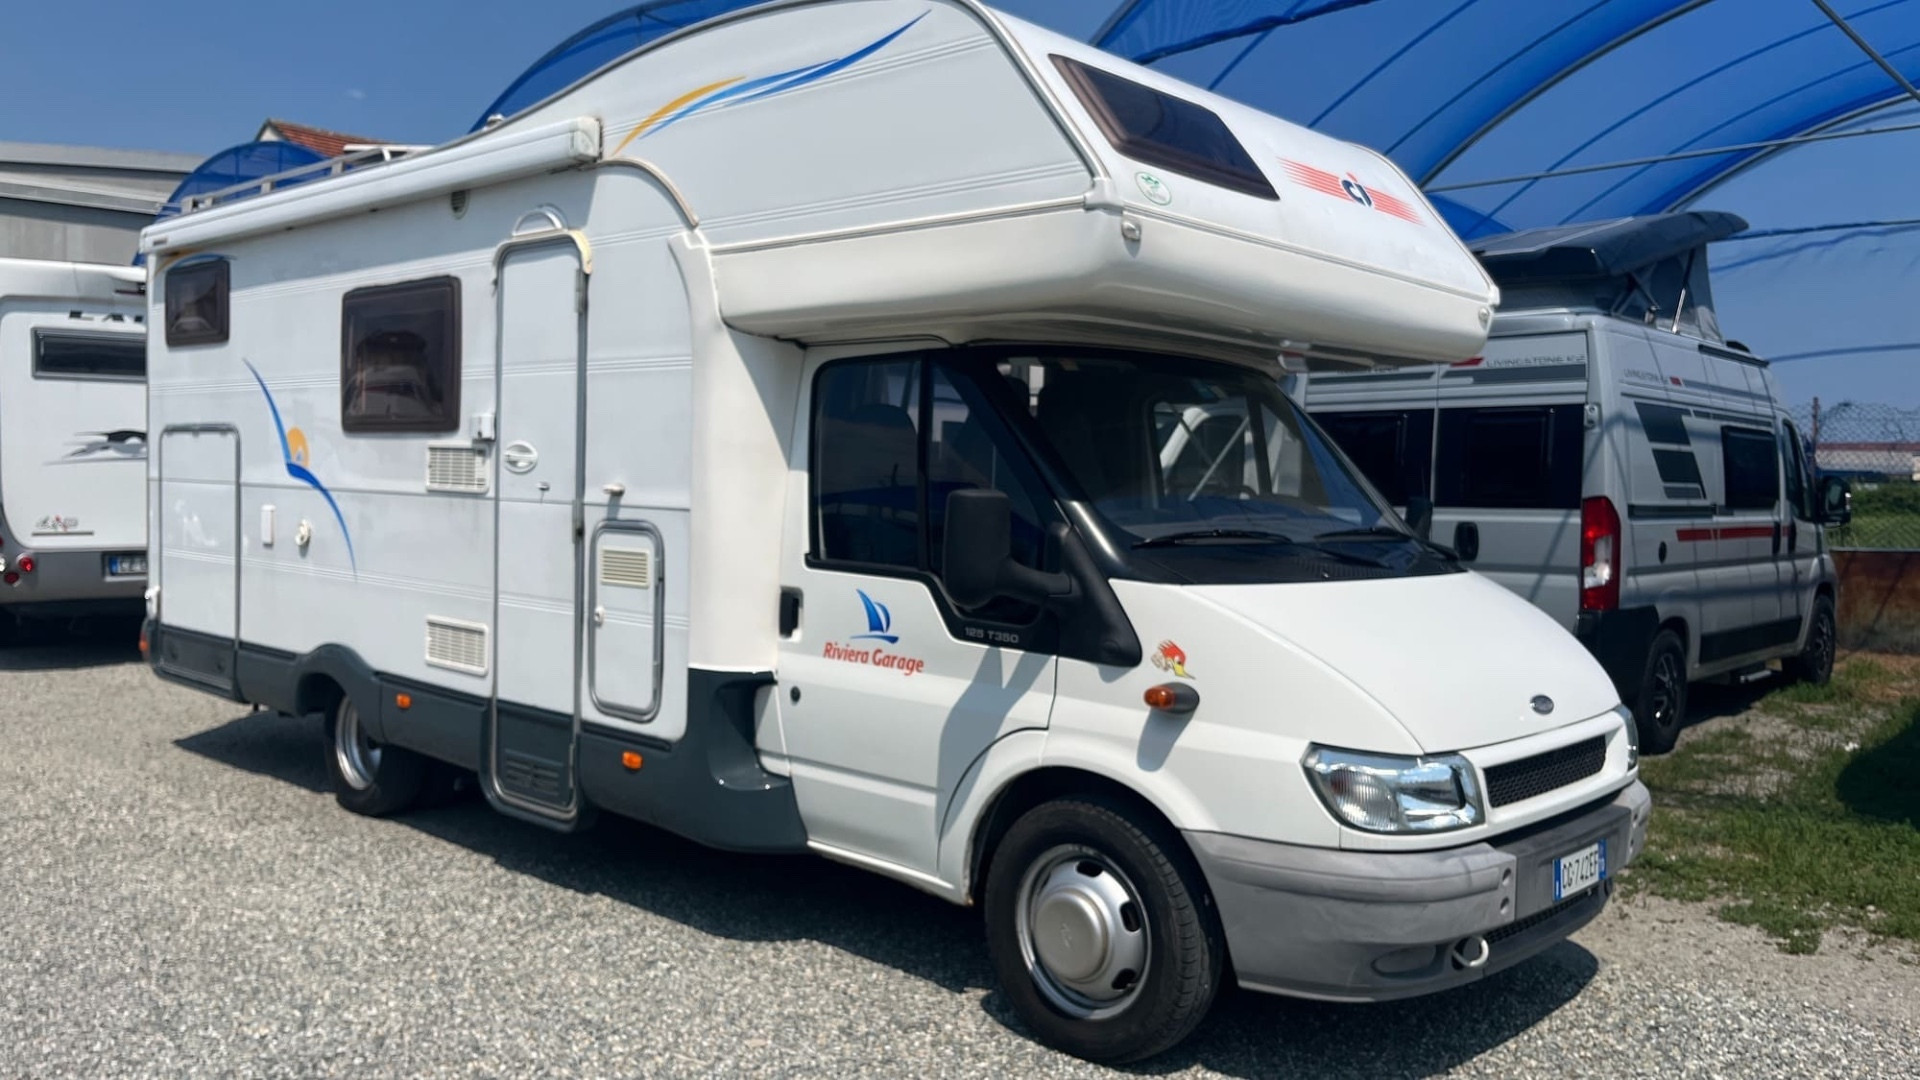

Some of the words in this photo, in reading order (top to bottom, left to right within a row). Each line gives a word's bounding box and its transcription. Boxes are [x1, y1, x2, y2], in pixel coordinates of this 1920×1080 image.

[1486, 356, 1564, 368] LIVINGSTONE
[965, 626, 984, 639] 125
[987, 630, 1020, 644] T350
[823, 642, 870, 664] Riviera
[872, 648, 925, 677] Garage
